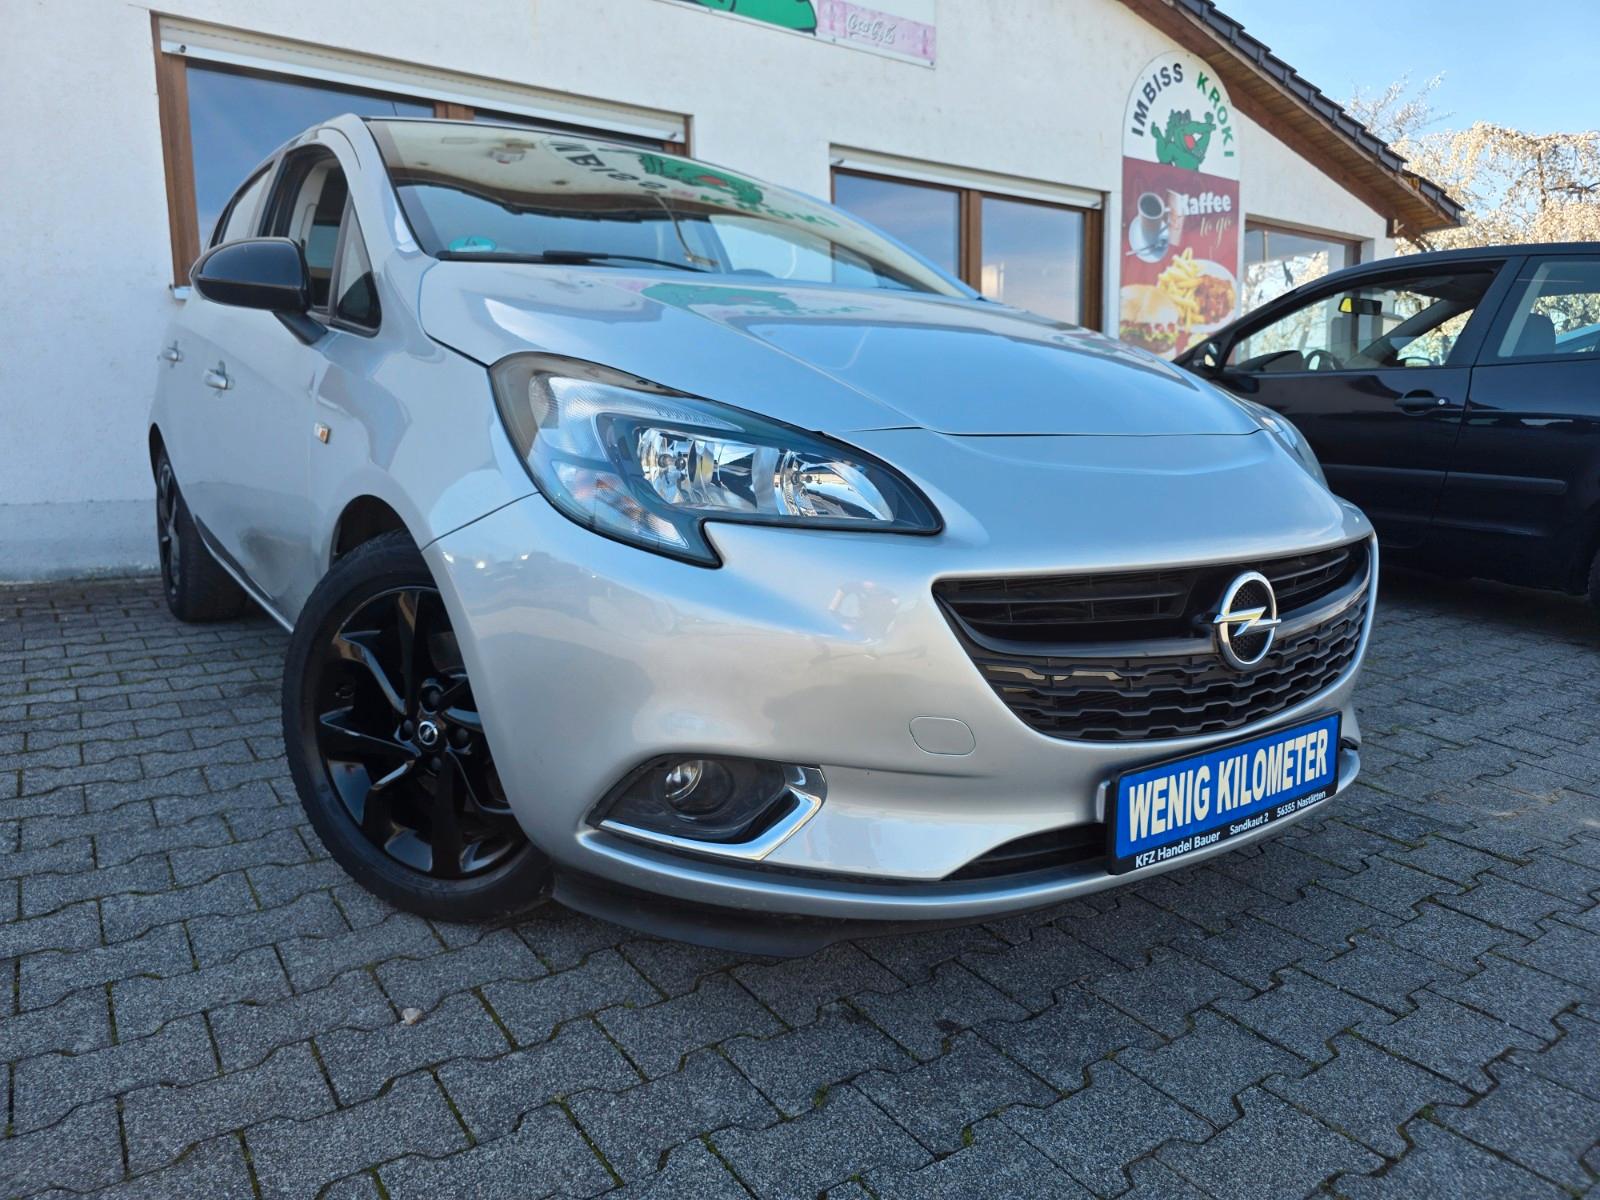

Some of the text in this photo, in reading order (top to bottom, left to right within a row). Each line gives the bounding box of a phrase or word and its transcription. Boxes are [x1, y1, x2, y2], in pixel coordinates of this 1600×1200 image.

[1131, 62, 1234, 157] IMBISS KROKI
[1179, 191, 1232, 216] Kaffee
[1200, 216, 1232, 249] to go
[1129, 728, 1329, 842] WENIG KILOMETER
[1135, 850, 1156, 868] KFZ
[1157, 837, 1193, 860] Handel
[1194, 831, 1221, 849] Bauer
[1229, 815, 1263, 835] Sandkaut
[1264, 812, 1269, 822] 2
[1276, 801, 1296, 818] 56355
